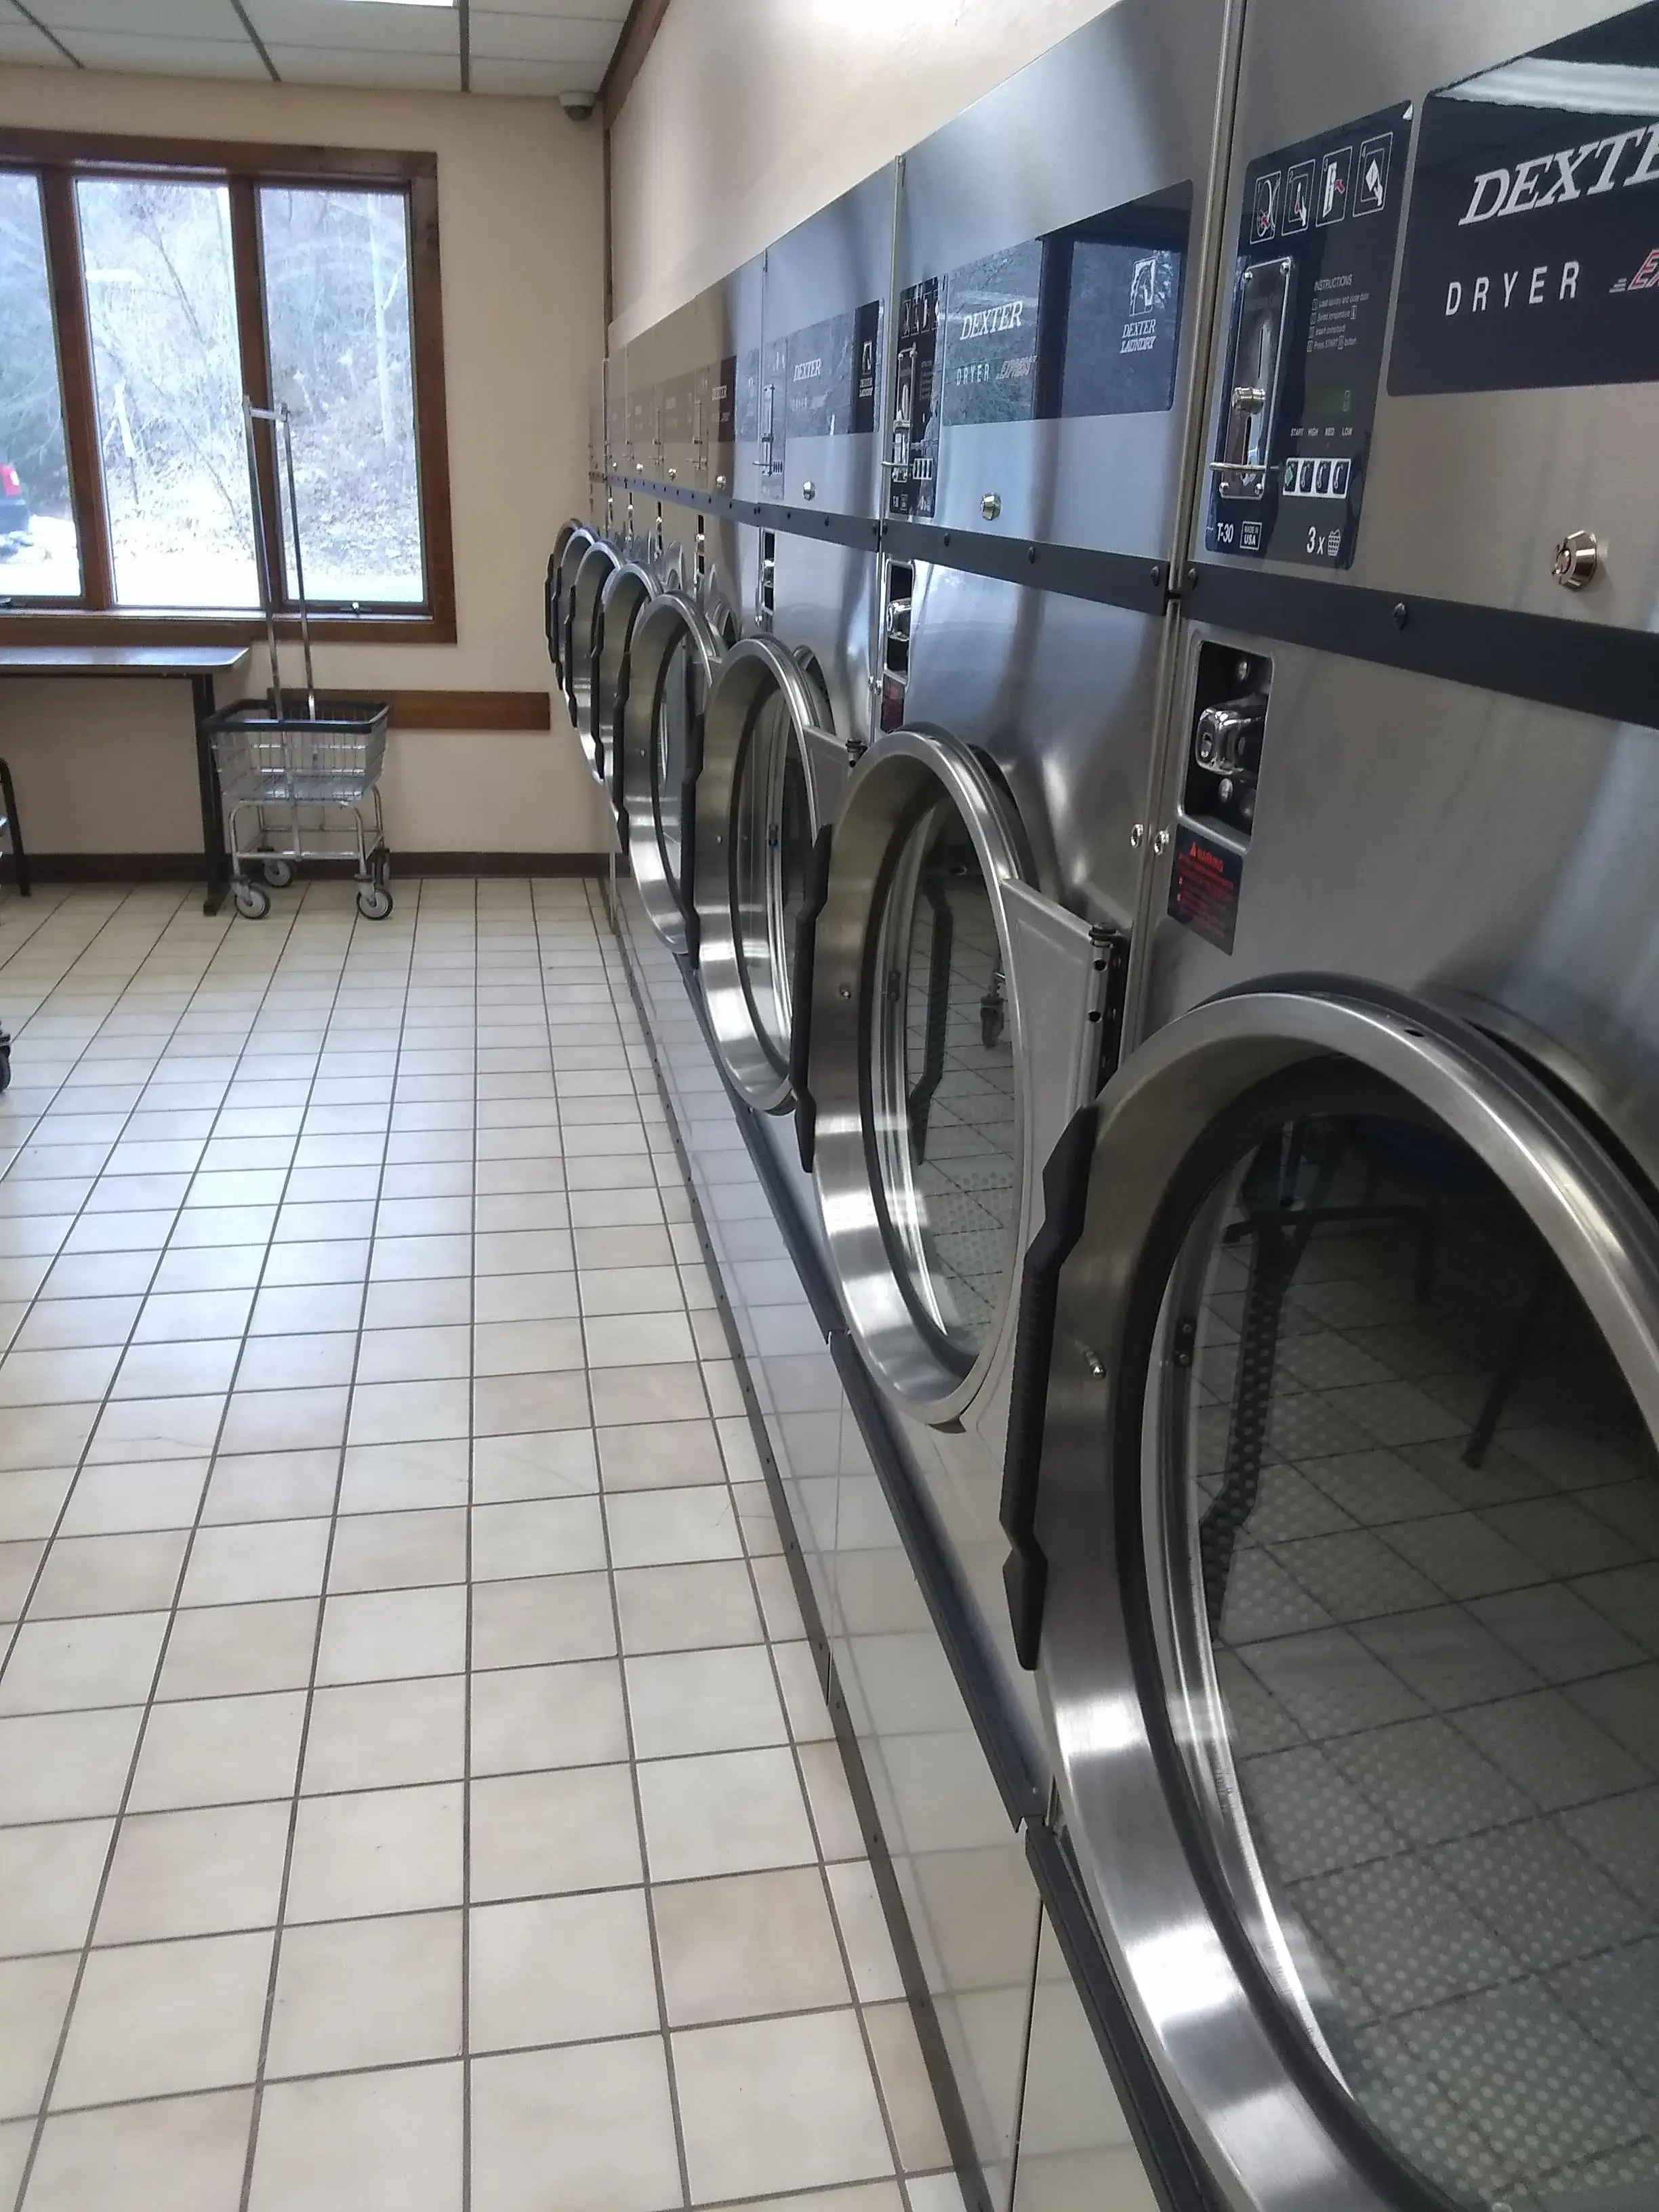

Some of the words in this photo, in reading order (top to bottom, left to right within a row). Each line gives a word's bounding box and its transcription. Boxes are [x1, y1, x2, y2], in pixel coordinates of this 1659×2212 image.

[1314, 274, 1353, 291] INSTRUCTIONS
[1446, 260, 1580, 316] DRYER
[960, 300, 1023, 340] DEXTER
[1122, 319, 1156, 338] DEXTER
[1120, 336, 1157, 353] LAUNDRY
[793, 358, 821, 382] DEXTER
[957, 363, 989, 386] DRYER
[1290, 428, 1304, 437] START
[1342, 426, 1353, 436] LOW
[1217, 523, 1234, 544] T-30
[1244, 534, 1256, 546] USA
[1306, 526, 1317, 554] 3
